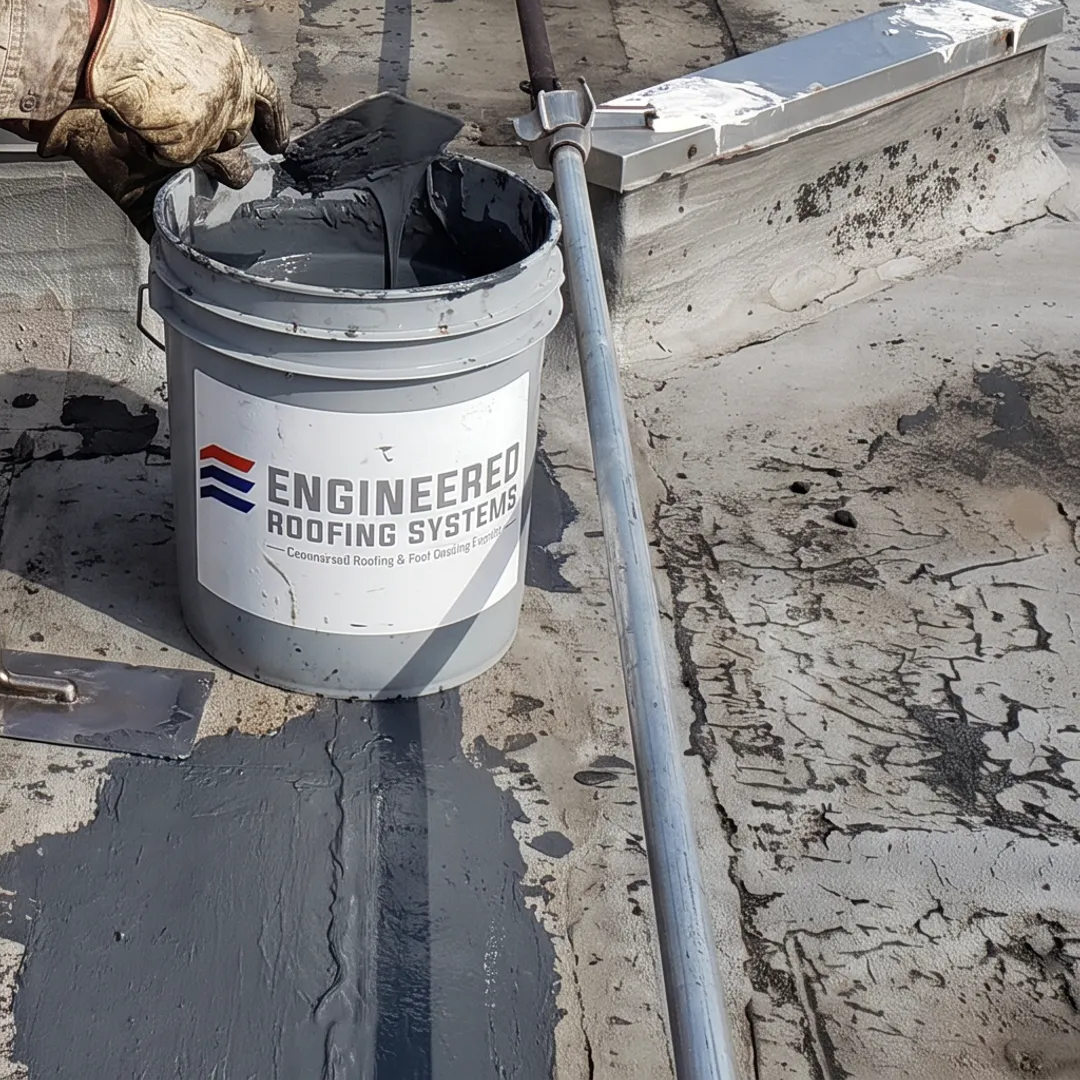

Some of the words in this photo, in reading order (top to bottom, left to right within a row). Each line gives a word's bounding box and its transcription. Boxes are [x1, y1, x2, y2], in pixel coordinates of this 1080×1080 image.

[267, 441, 520, 517] ENGINEERED
[267, 508, 397, 548] ROOFING
[407, 483, 518, 545] SYSTEMS
[353, 555, 395, 568] Roofing
[397, 554, 405, 565] &
